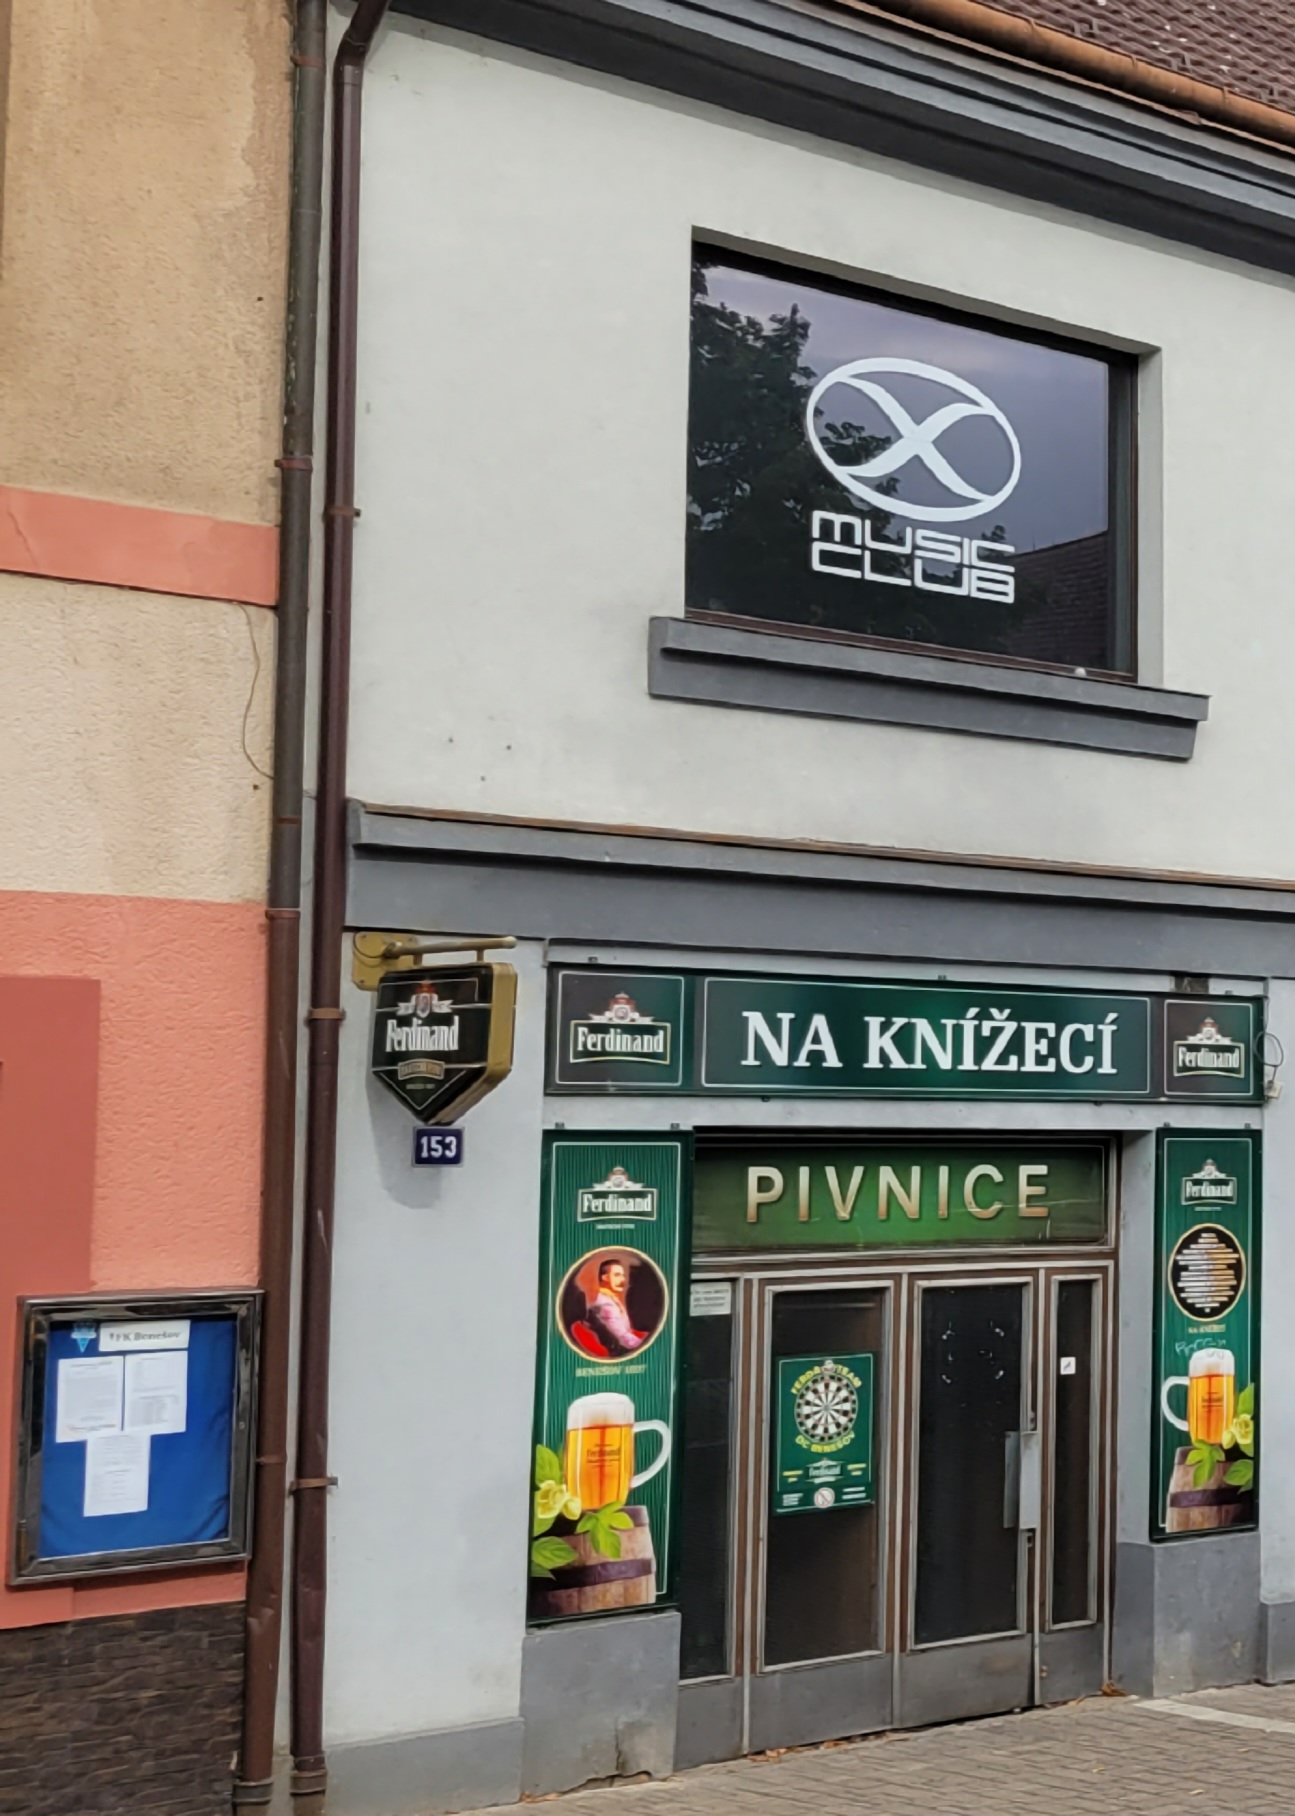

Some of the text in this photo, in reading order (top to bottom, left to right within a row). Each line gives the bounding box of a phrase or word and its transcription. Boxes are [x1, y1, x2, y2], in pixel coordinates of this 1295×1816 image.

[812, 510, 1015, 573] MUSIC
[812, 541, 1015, 604] CLUB
[386, 1015, 459, 1052] Ferdinand
[577, 1027, 665, 1053] Ferdinand
[741, 1007, 1117, 1075] NA KNÍŽECÍ
[1178, 1046, 1240, 1068] Ferdinand
[420, 1135, 458, 1159] 153
[582, 1193, 653, 1213] Ferdinand
[747, 1164, 1051, 1223] PIVNICE
[1185, 1180, 1234, 1198] Ferdinand
